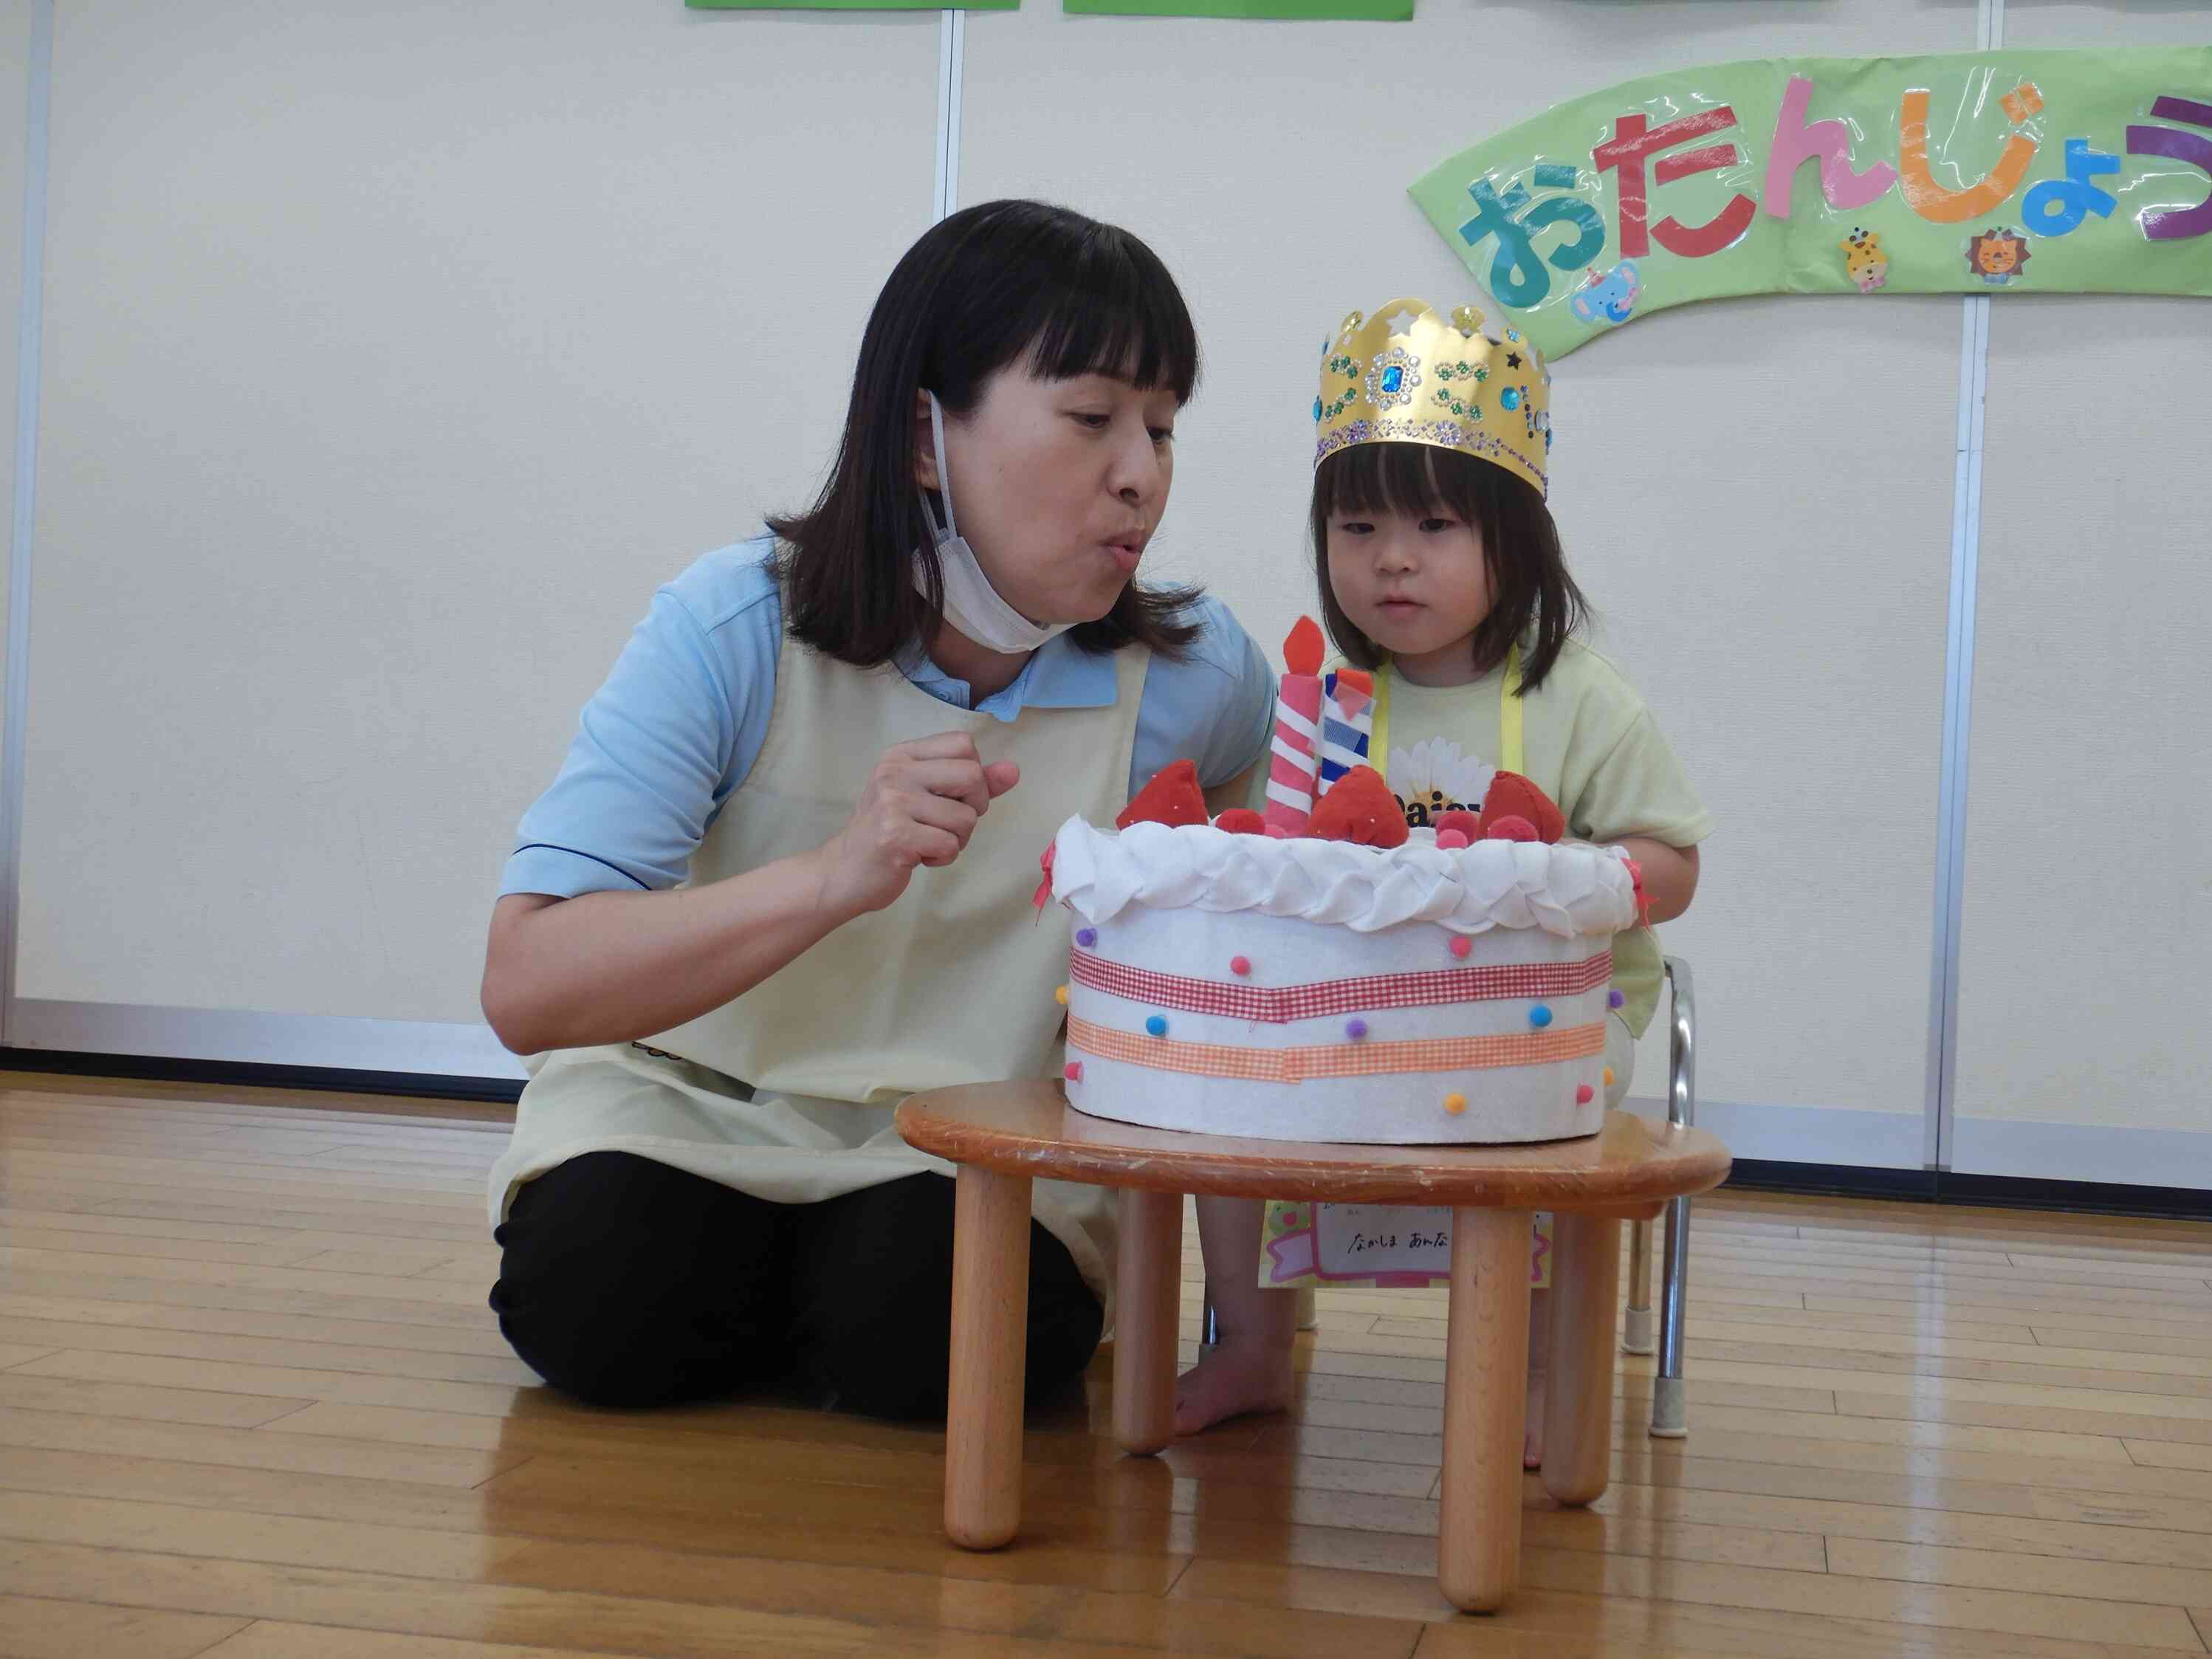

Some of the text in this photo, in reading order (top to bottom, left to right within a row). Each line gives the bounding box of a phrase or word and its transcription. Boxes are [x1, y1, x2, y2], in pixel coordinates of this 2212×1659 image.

[1459, 74, 2212, 309] おたんじょう
